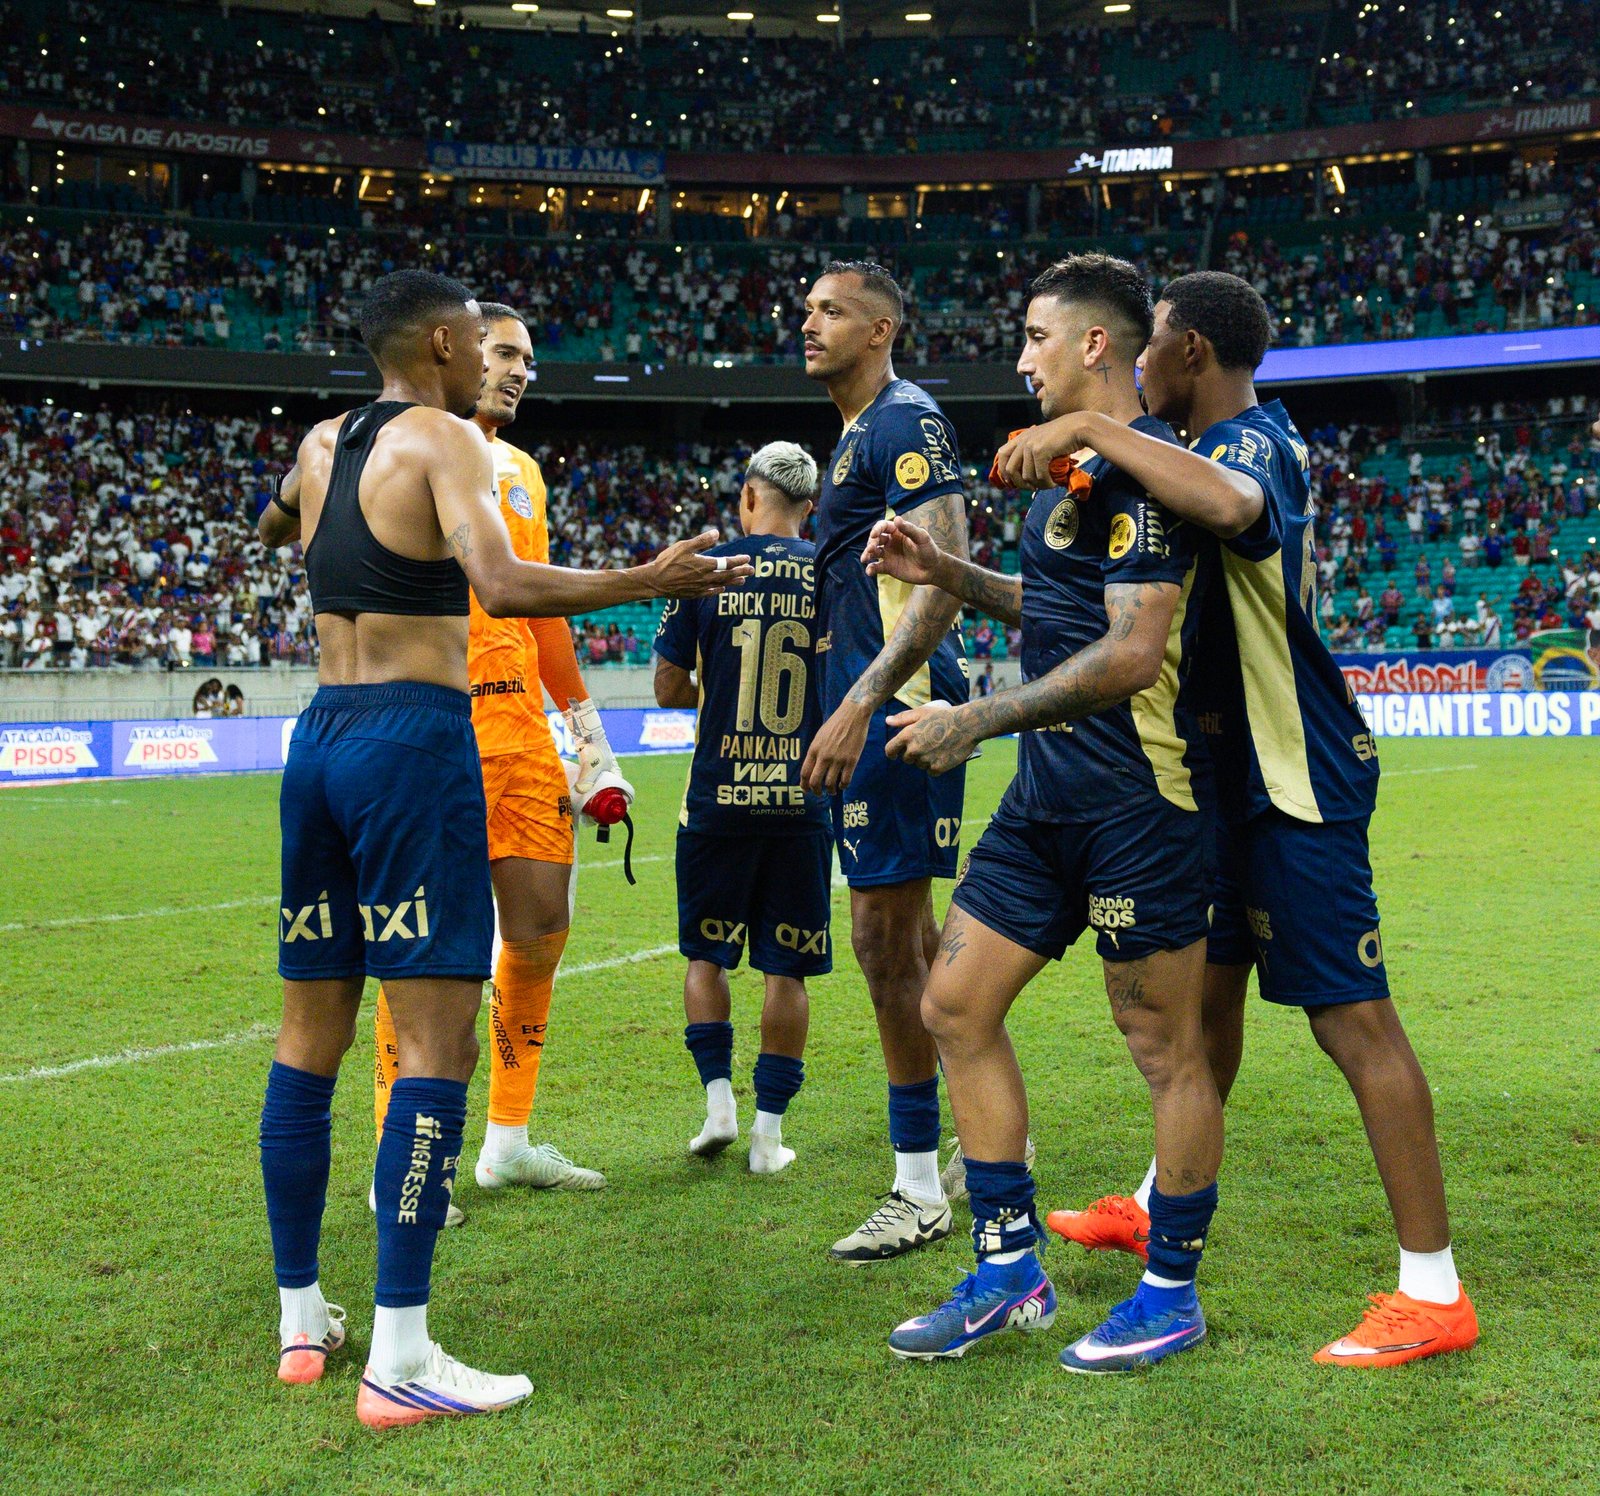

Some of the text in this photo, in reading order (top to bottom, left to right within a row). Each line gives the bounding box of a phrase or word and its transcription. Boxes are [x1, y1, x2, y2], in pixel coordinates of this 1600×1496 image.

[1515, 102, 1591, 132] ITAIPAVA
[64, 121, 270, 155] CASA DE APOSTAS
[461, 144, 632, 172] JESUS TE AMA
[1101, 146, 1173, 173] ITAIPAVA
[1136, 502, 1146, 553] Alimentos
[788, 554, 814, 563] banco
[755, 555, 815, 592] bmg
[718, 591, 766, 616] ERICK
[731, 618, 811, 735] 16
[1353, 691, 1493, 736] GIGANTE
[1500, 690, 1572, 736] DOS
[15, 747, 77, 766] PISOS
[143, 743, 199, 761] PISOS
[720, 734, 801, 761] PANKARU
[734, 762, 787, 783] VIVA
[717, 785, 805, 806] SORTE
[750, 808, 806, 816] CAPITALIZAÇÃO
[492, 1005, 521, 1070] INGRESSE
